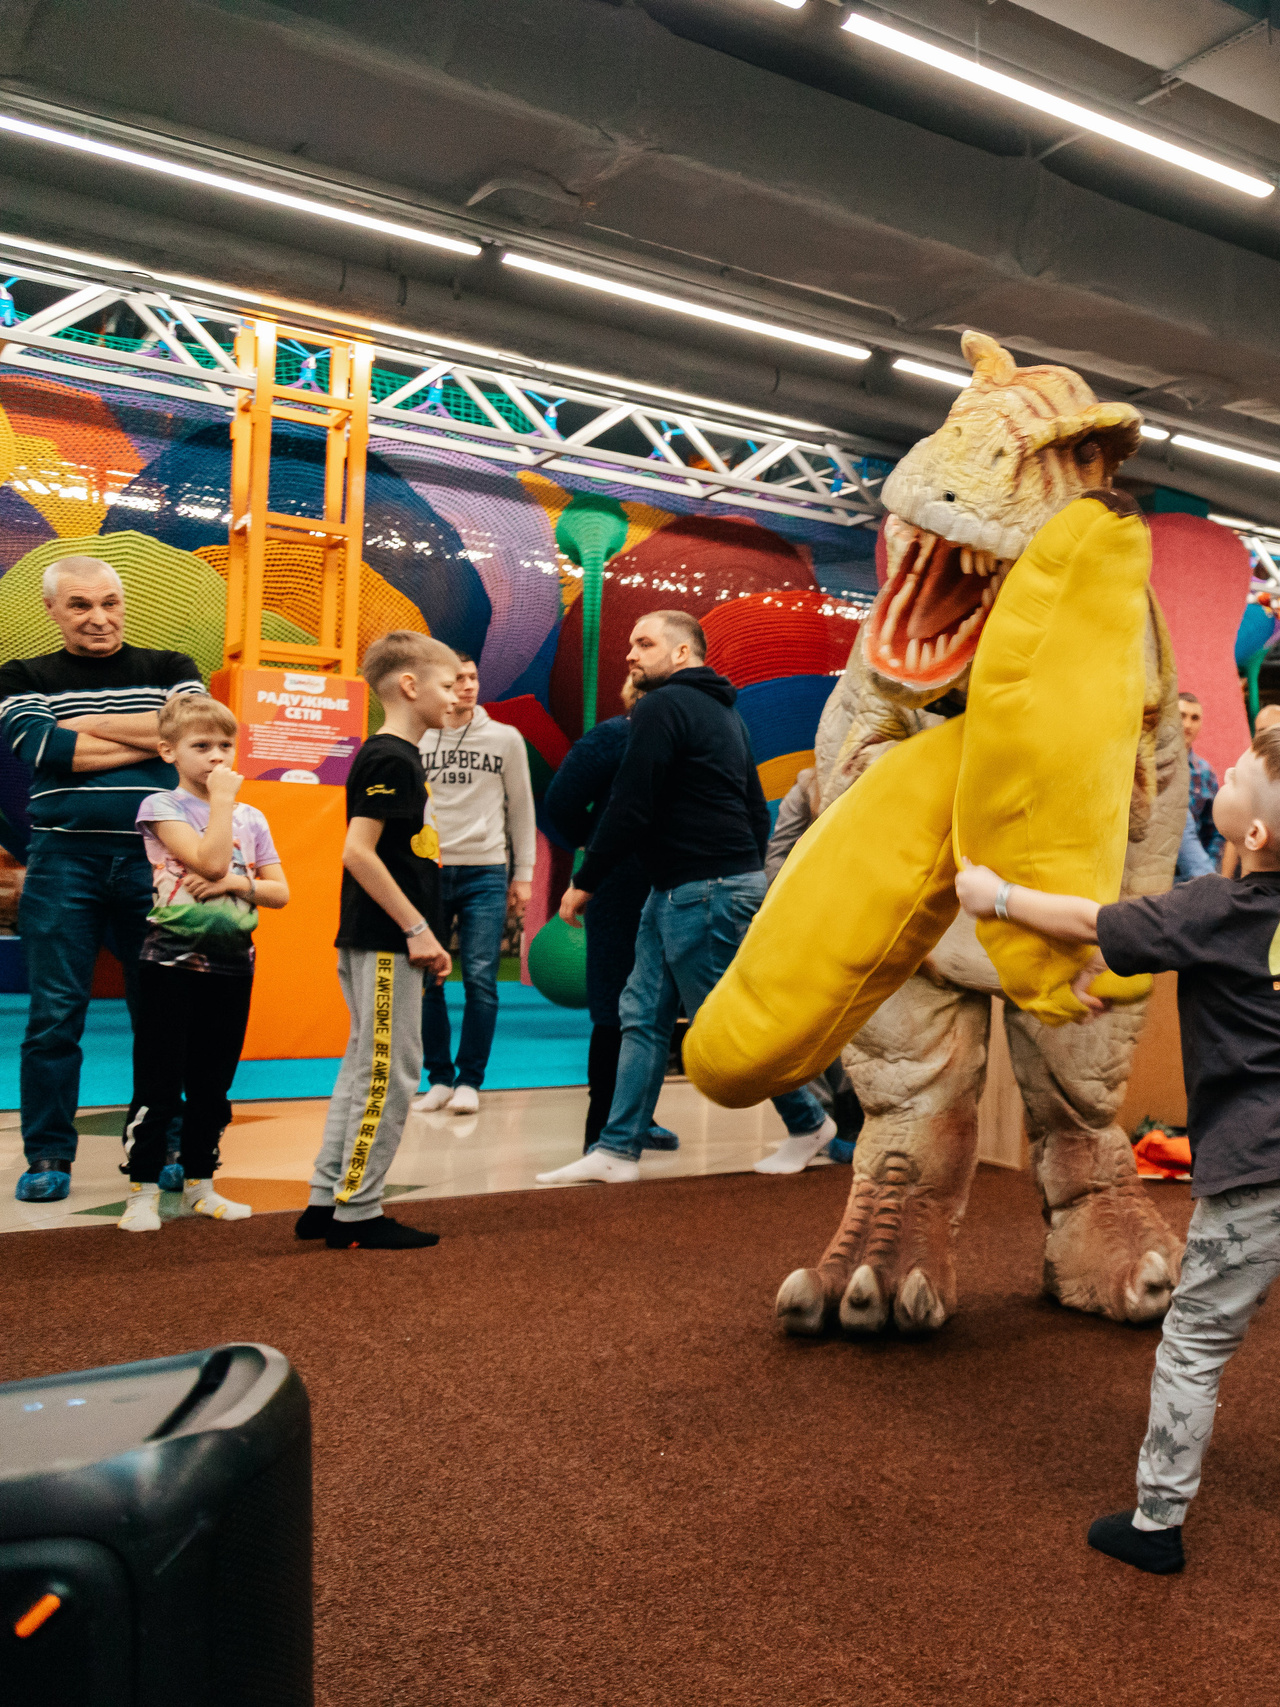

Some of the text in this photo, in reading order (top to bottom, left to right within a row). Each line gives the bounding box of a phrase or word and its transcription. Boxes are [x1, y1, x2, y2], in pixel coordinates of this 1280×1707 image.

[257, 690, 349, 711] РАДУЖНЫЕ
[285, 706, 322, 721] СЕТИ
[419, 749, 503, 774] ULL&BEAR
[441, 772, 472, 784] 1991
[377, 958, 391, 974] BE
[375, 976, 391, 1034] AWESOME
[374, 1042, 389, 1058] BE
[366, 1060, 387, 1117] AWESOME
[360, 1123, 375, 1139] BE
